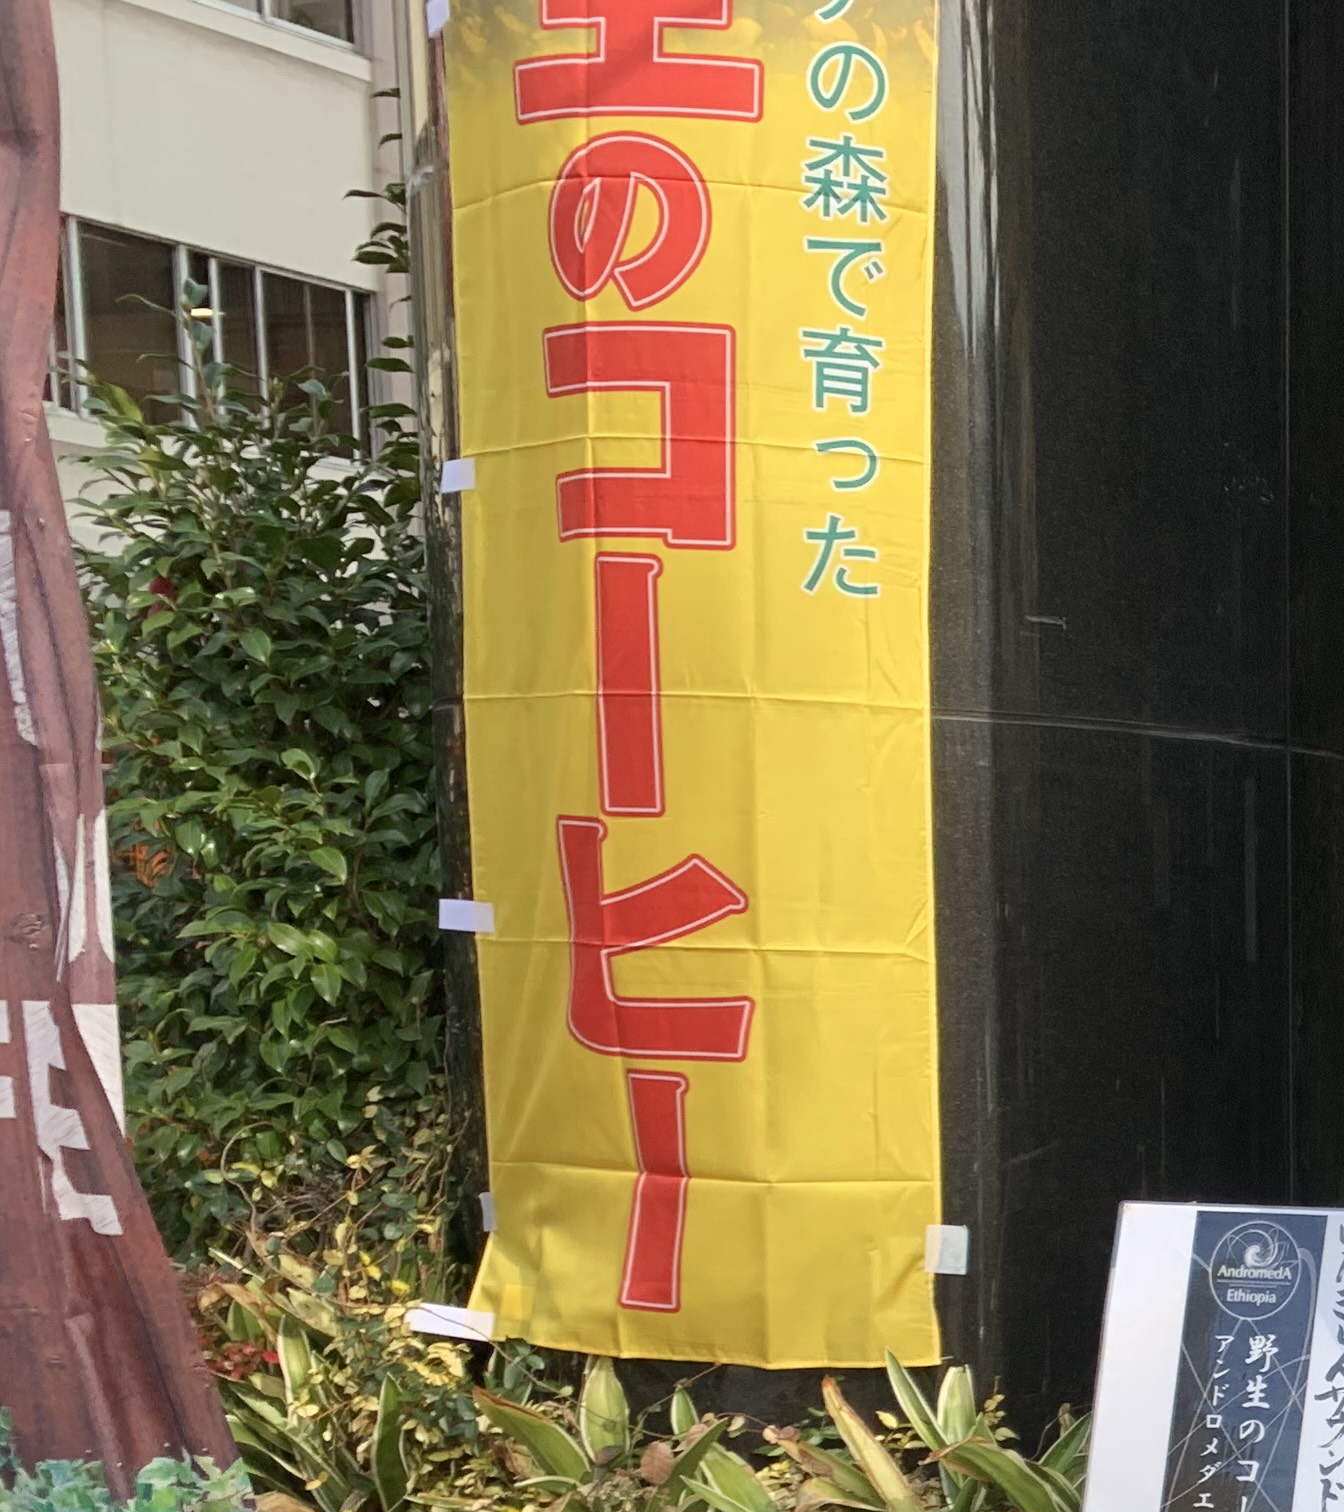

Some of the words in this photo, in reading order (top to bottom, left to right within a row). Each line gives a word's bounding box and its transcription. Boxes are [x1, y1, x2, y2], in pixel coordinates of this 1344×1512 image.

[801, 0, 889, 597] の森で育った
[1216, 1264, 1293, 1281] AndromedA
[1226, 1288, 1277, 1306] Ethiopia
